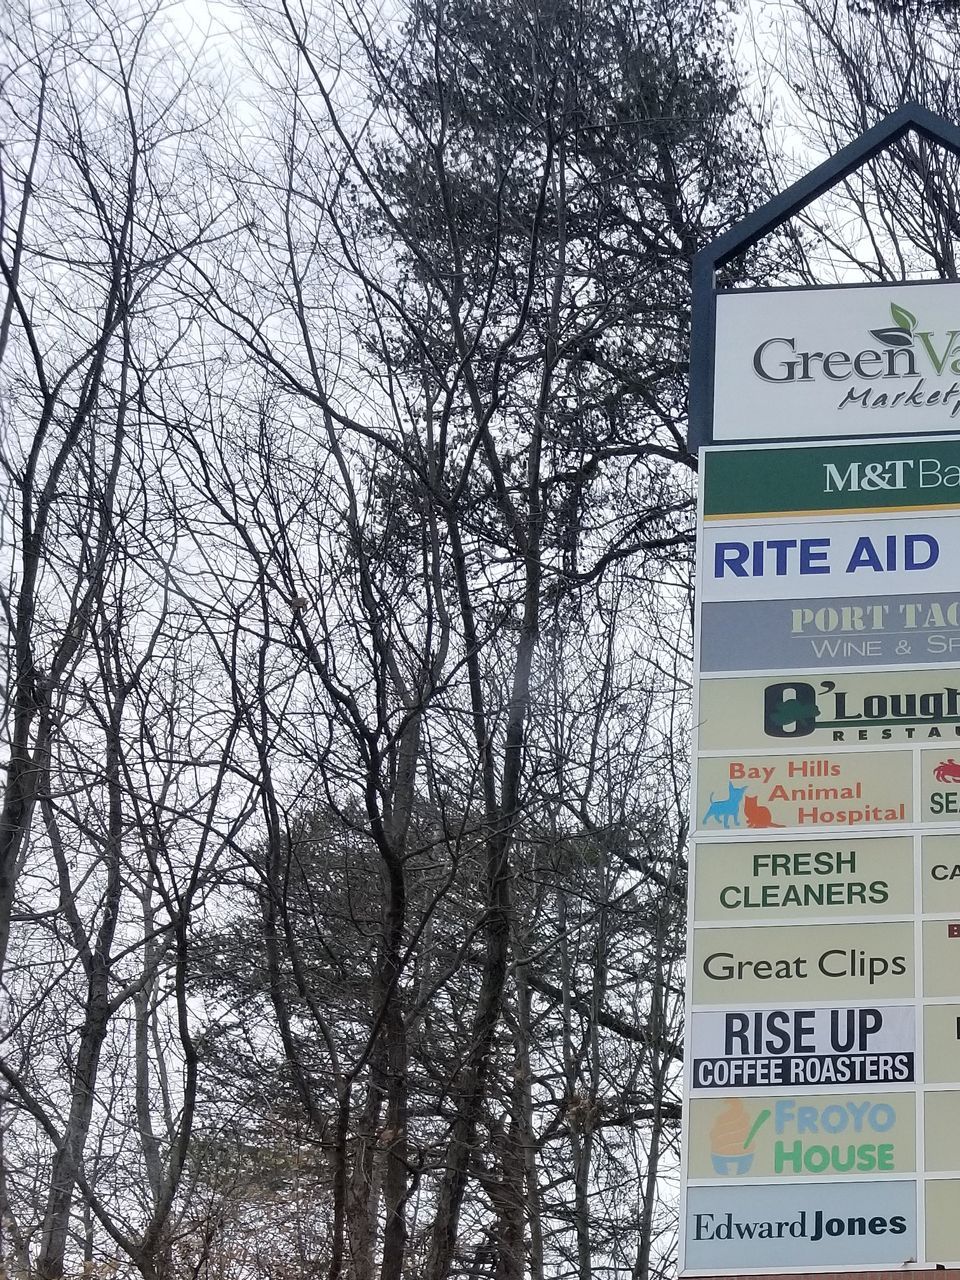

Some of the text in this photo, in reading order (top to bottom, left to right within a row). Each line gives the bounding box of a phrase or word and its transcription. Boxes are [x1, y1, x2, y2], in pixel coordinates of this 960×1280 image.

[824, 460, 913, 493] M&T
[714, 538, 831, 578] RITE
[846, 534, 939, 573] AID
[791, 605, 889, 632] PORT
[811, 638, 882, 658] WINE
[896, 640, 912, 655] &
[729, 760, 840, 784] Bay Hills
[768, 783, 861, 801] Animal
[798, 804, 905, 826] Hospital
[753, 851, 856, 877] FRESH
[719, 881, 888, 909] CLEANERS
[703, 949, 906, 984] Great Clips
[724, 1009, 883, 1056] RISE UP
[698, 1052, 909, 1086] COFFEE ROASTERS
[774, 1100, 896, 1135] FROYO
[774, 1140, 895, 1173] HOUSE
